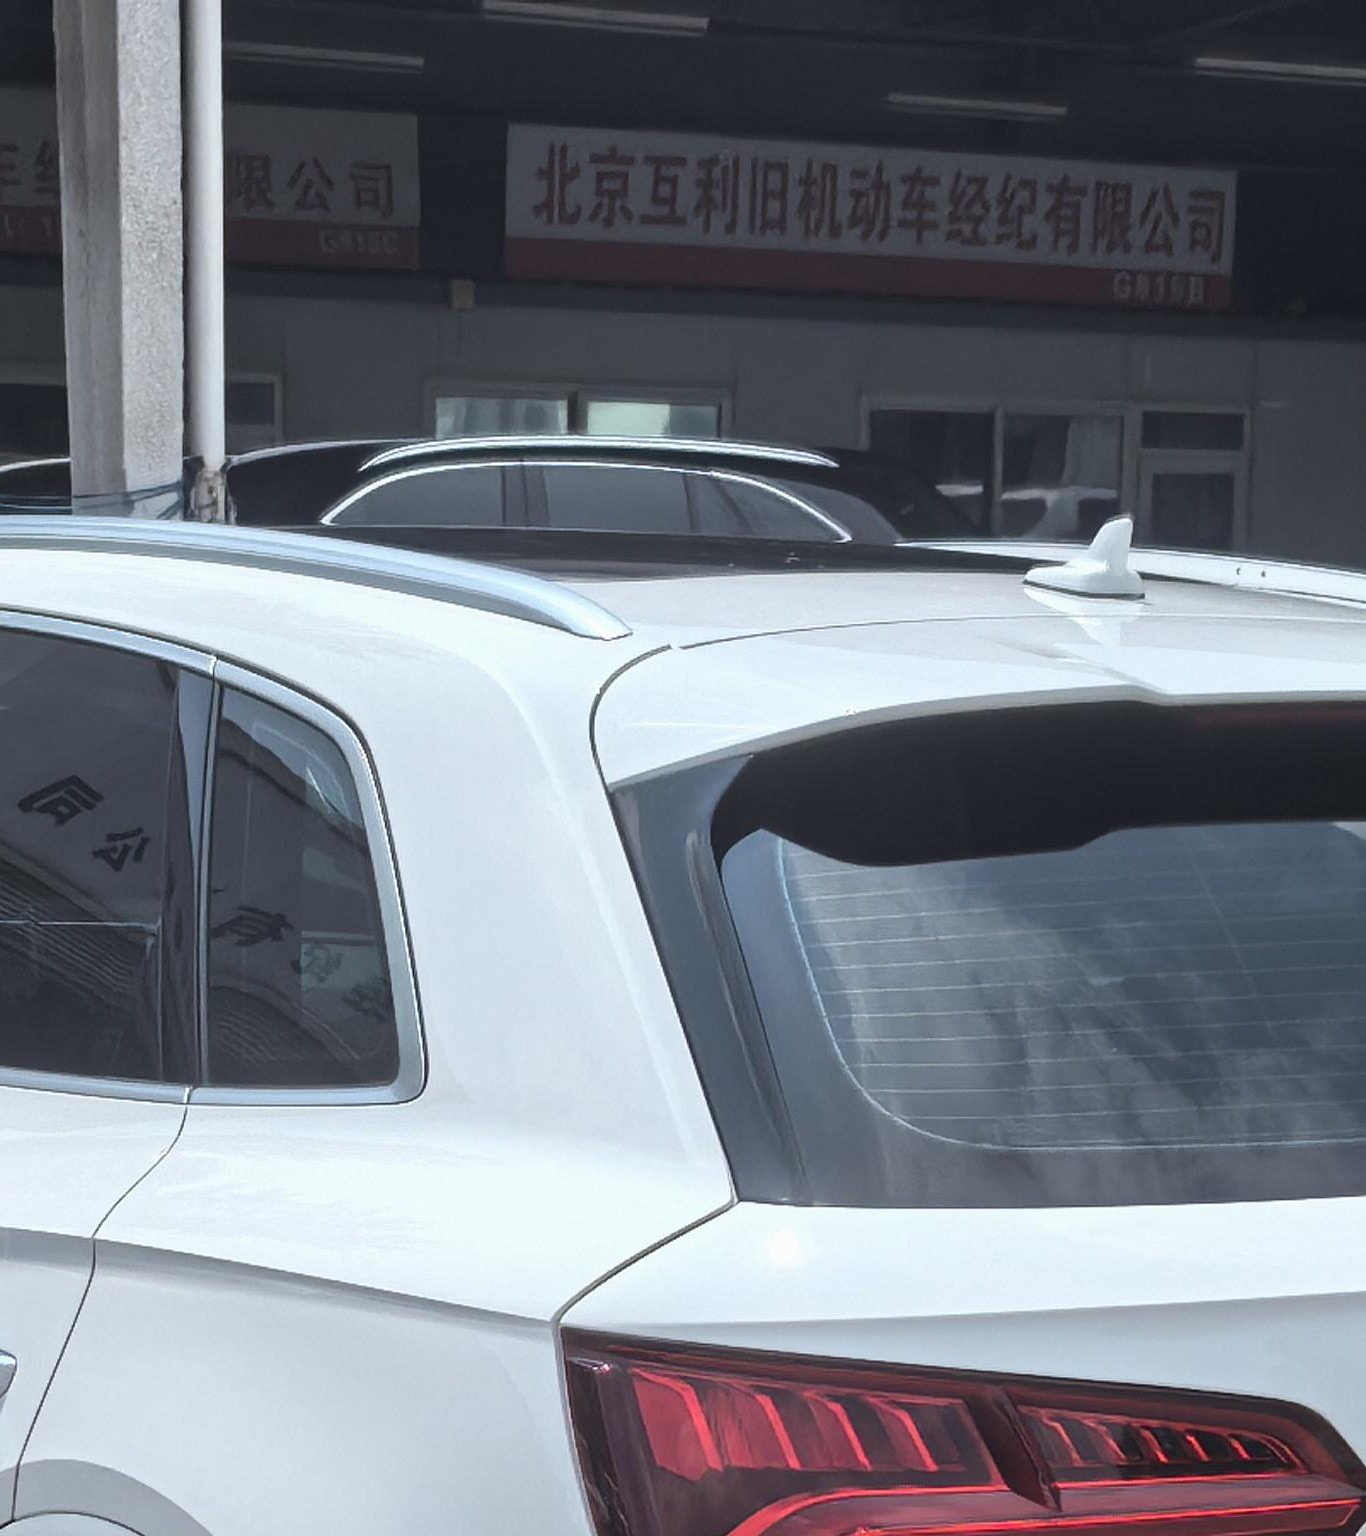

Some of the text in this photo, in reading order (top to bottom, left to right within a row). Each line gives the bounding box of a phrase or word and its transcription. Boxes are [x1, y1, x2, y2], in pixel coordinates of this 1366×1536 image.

[534, 140, 1227, 265] 北京互利旧机动车经纪有限公司
